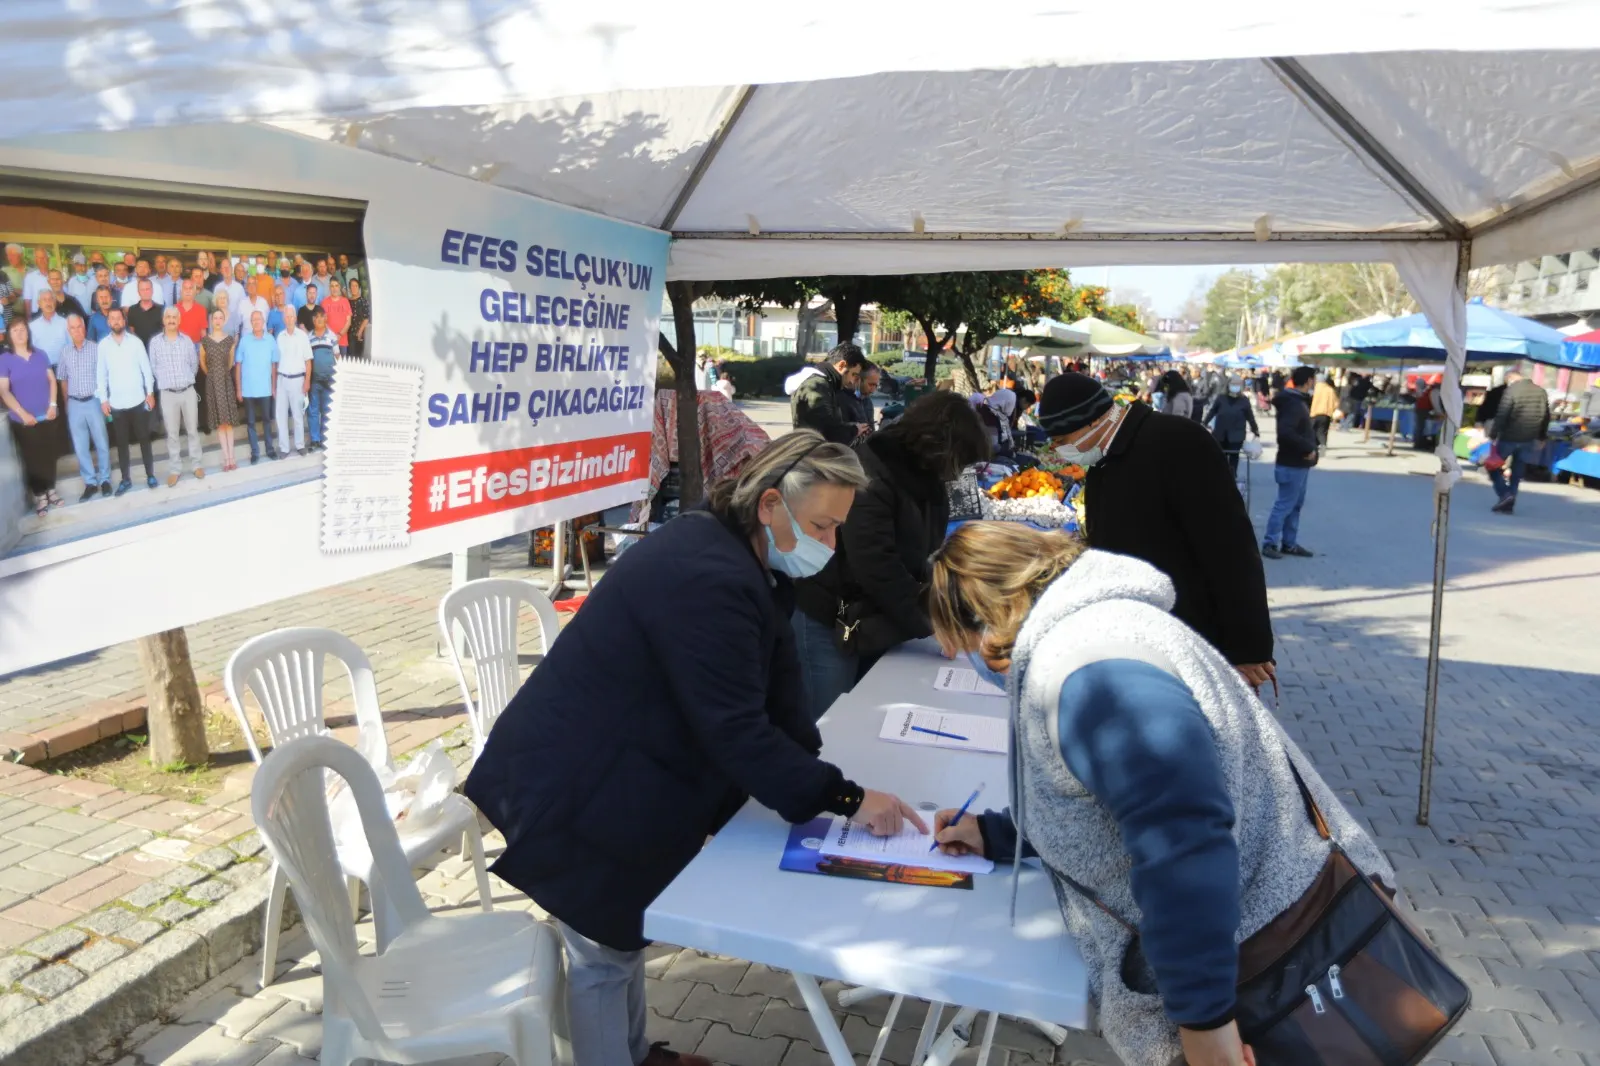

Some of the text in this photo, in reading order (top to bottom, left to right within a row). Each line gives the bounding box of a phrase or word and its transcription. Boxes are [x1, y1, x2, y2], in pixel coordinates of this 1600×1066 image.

[441, 228, 518, 273] EFES
[480, 288, 630, 330] GELECEĞİNE
[469, 337, 629, 373] HEP BİRLİKTE
[427, 384, 521, 428] SAHİP
[528, 379, 645, 427] ÇIKACAĞIZ!
[429, 444, 636, 513] #EfesBizimdir
